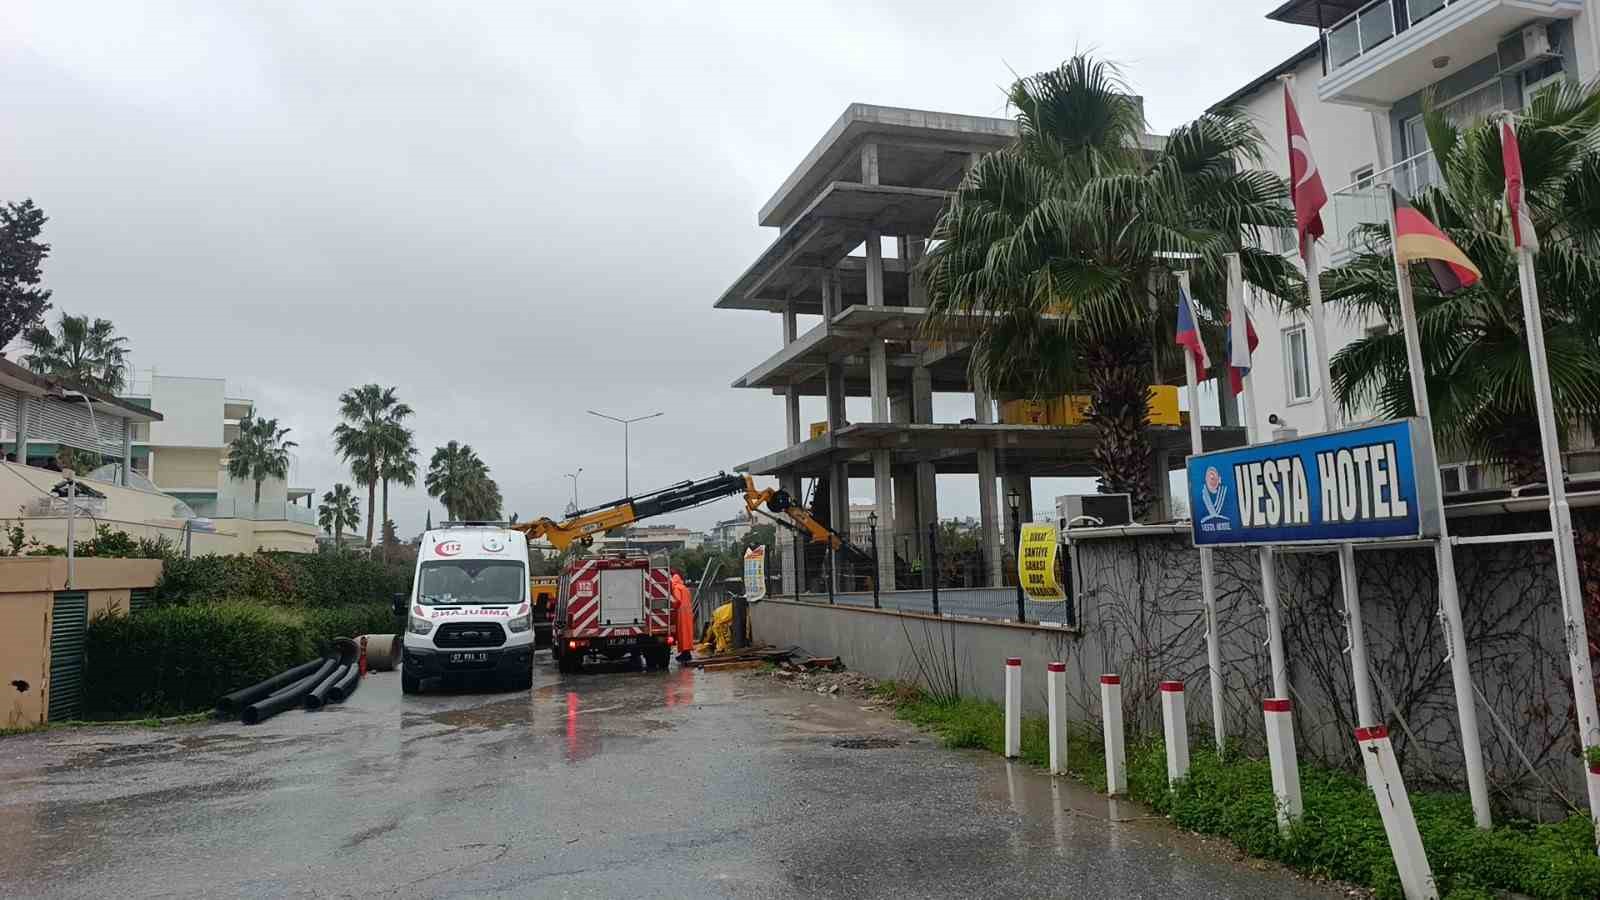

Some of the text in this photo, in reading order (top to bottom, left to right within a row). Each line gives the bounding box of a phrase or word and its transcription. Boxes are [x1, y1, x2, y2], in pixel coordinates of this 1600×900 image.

[1234, 442, 1408, 527] VESTA HOTEL
[446, 543, 461, 551] 112
